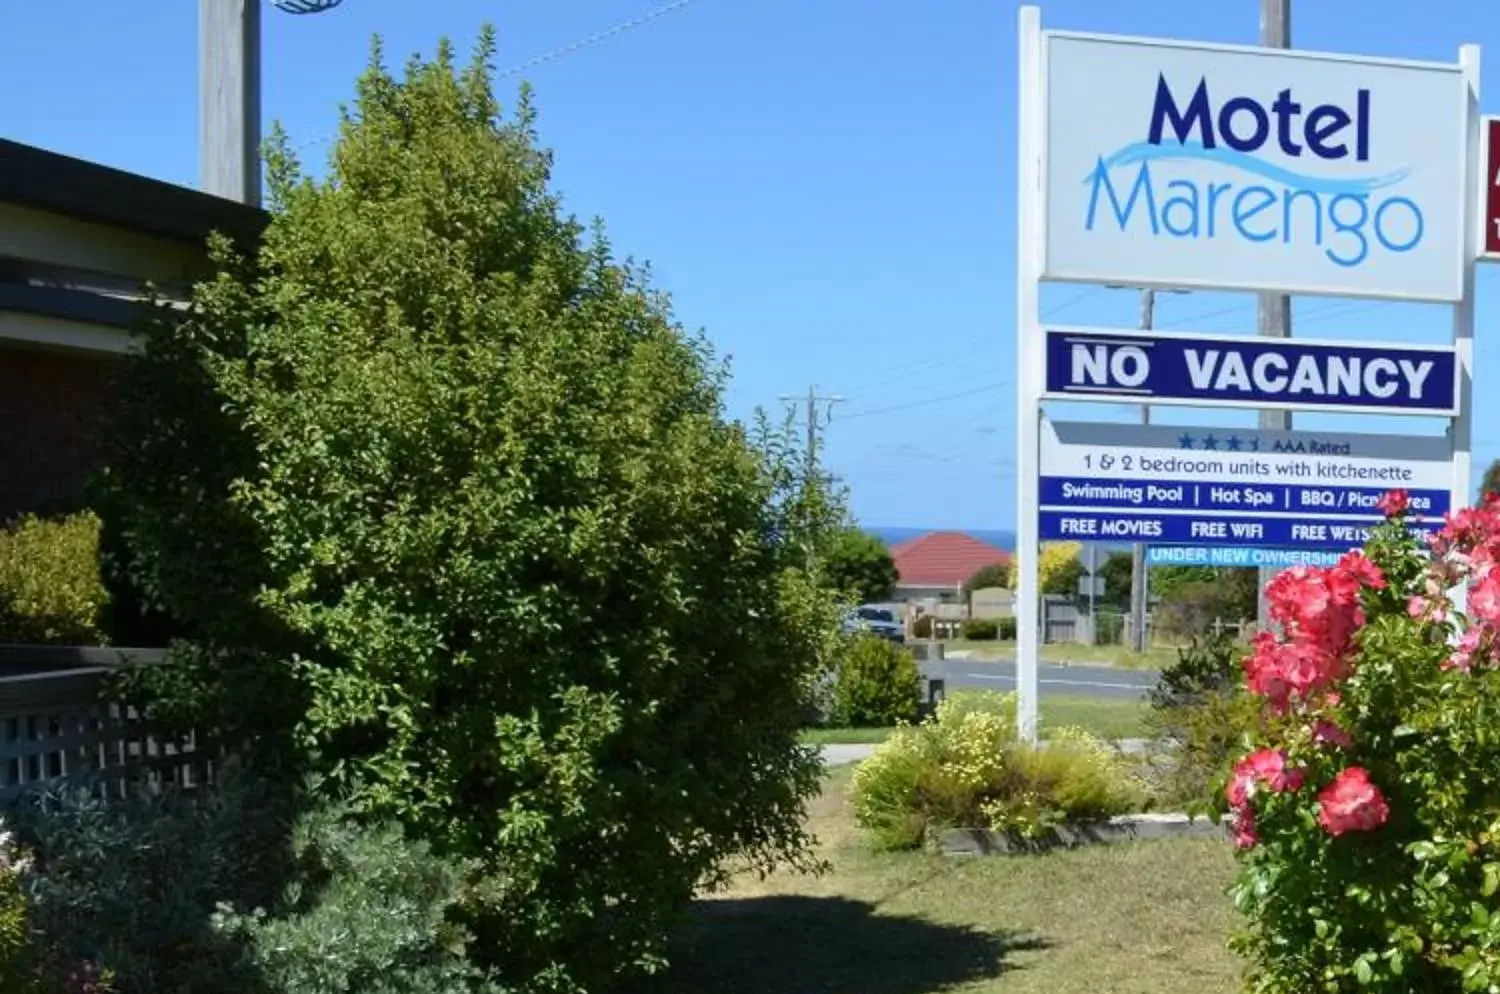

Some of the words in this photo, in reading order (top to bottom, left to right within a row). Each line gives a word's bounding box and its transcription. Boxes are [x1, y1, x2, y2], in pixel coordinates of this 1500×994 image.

[1147, 71, 1370, 162] Motel
[1083, 154, 1424, 267] Marengo
[1070, 344, 1150, 388] NO
[1184, 349, 1433, 399] VACANCY
[1273, 439, 1305, 453] AAA
[1309, 440, 1350, 455] Rated
[1084, 454, 1092, 469] 1
[1100, 454, 1115, 470] &
[1122, 455, 1133, 471] 2
[1140, 456, 1223, 473] bedroom
[1229, 459, 1270, 475] units
[1276, 461, 1311, 477] with
[1317, 462, 1413, 481] kitchenette
[1062, 482, 1142, 503] Swimming
[1148, 485, 1183, 501] Pool
[1211, 487, 1240, 503] Hot
[1243, 488, 1274, 507] Spa
[1301, 490, 1335, 507] BBQ
[1404, 497, 1431, 509] rea
[1060, 518, 1097, 534] FREE
[1101, 520, 1163, 536] MOVIES
[1191, 521, 1227, 538] FREE
[1230, 522, 1263, 539] WIFI
[1291, 524, 1327, 540] FREE
[1151, 548, 1207, 562] UNDER
[1211, 549, 1250, 563] NEW
